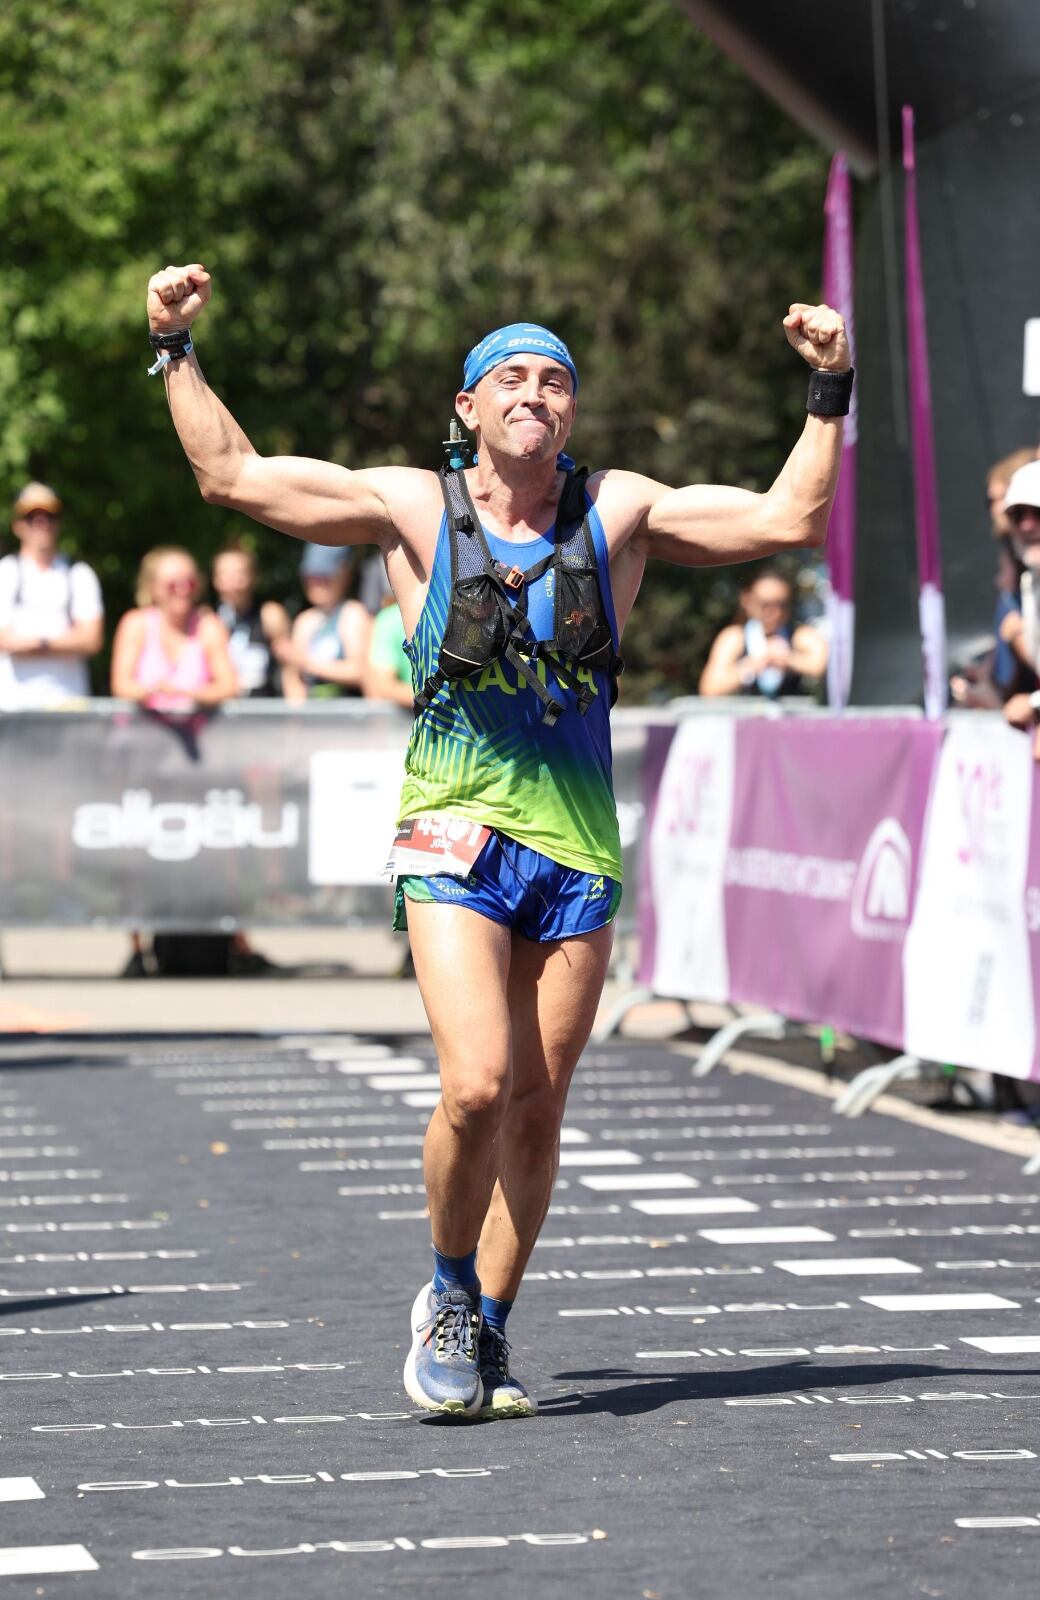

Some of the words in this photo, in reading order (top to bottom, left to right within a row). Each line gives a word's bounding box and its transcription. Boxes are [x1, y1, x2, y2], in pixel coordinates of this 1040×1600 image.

[545, 575, 554, 598] CLUB
[72, 788, 300, 861] allgäu
[634, 1343, 951, 1359] allgäu
[0, 1362, 346, 1381] outlet
[31, 1410, 413, 1433] outlet
[828, 1448, 1040, 1463] allg
[76, 1467, 492, 1492] outlet
[131, 1532, 590, 1561] outlet
